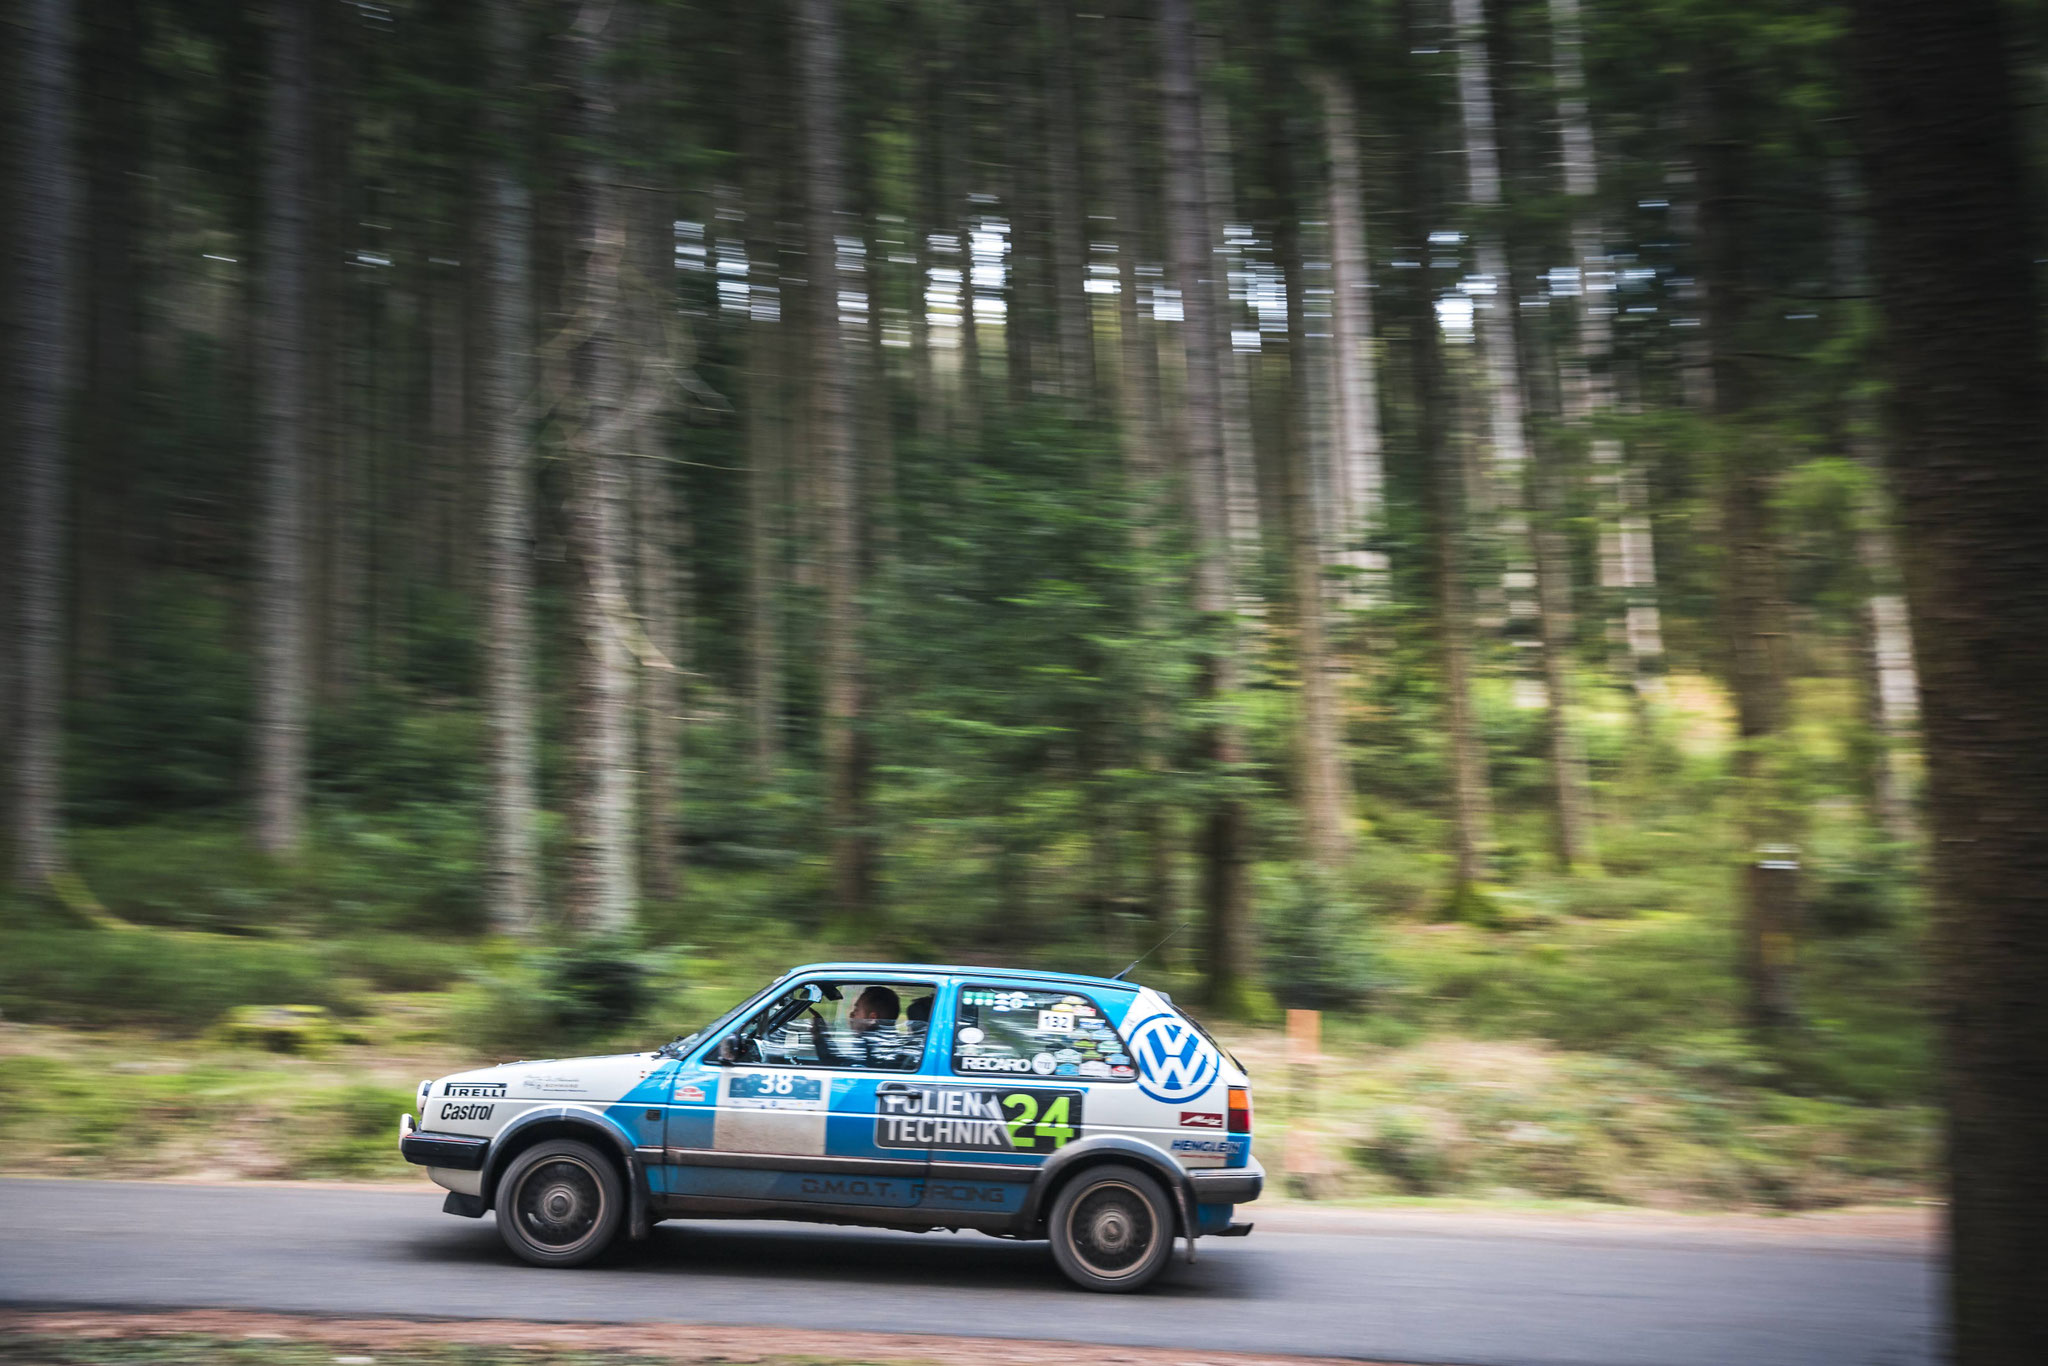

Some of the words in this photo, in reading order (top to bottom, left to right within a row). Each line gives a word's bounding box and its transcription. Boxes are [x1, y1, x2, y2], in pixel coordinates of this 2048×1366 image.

[1044, 1016, 1068, 1029] 132
[961, 1057, 1032, 1072] RECARO
[1134, 1020, 1214, 1096] VW
[444, 1083, 507, 1097] PIRELLI
[757, 1072, 794, 1095] 38
[440, 1103, 495, 1121] Castrol
[1002, 1093, 1075, 1149] 24
[885, 1117, 1002, 1146] TECHNIK
[910, 1183, 1004, 1203] RACING
